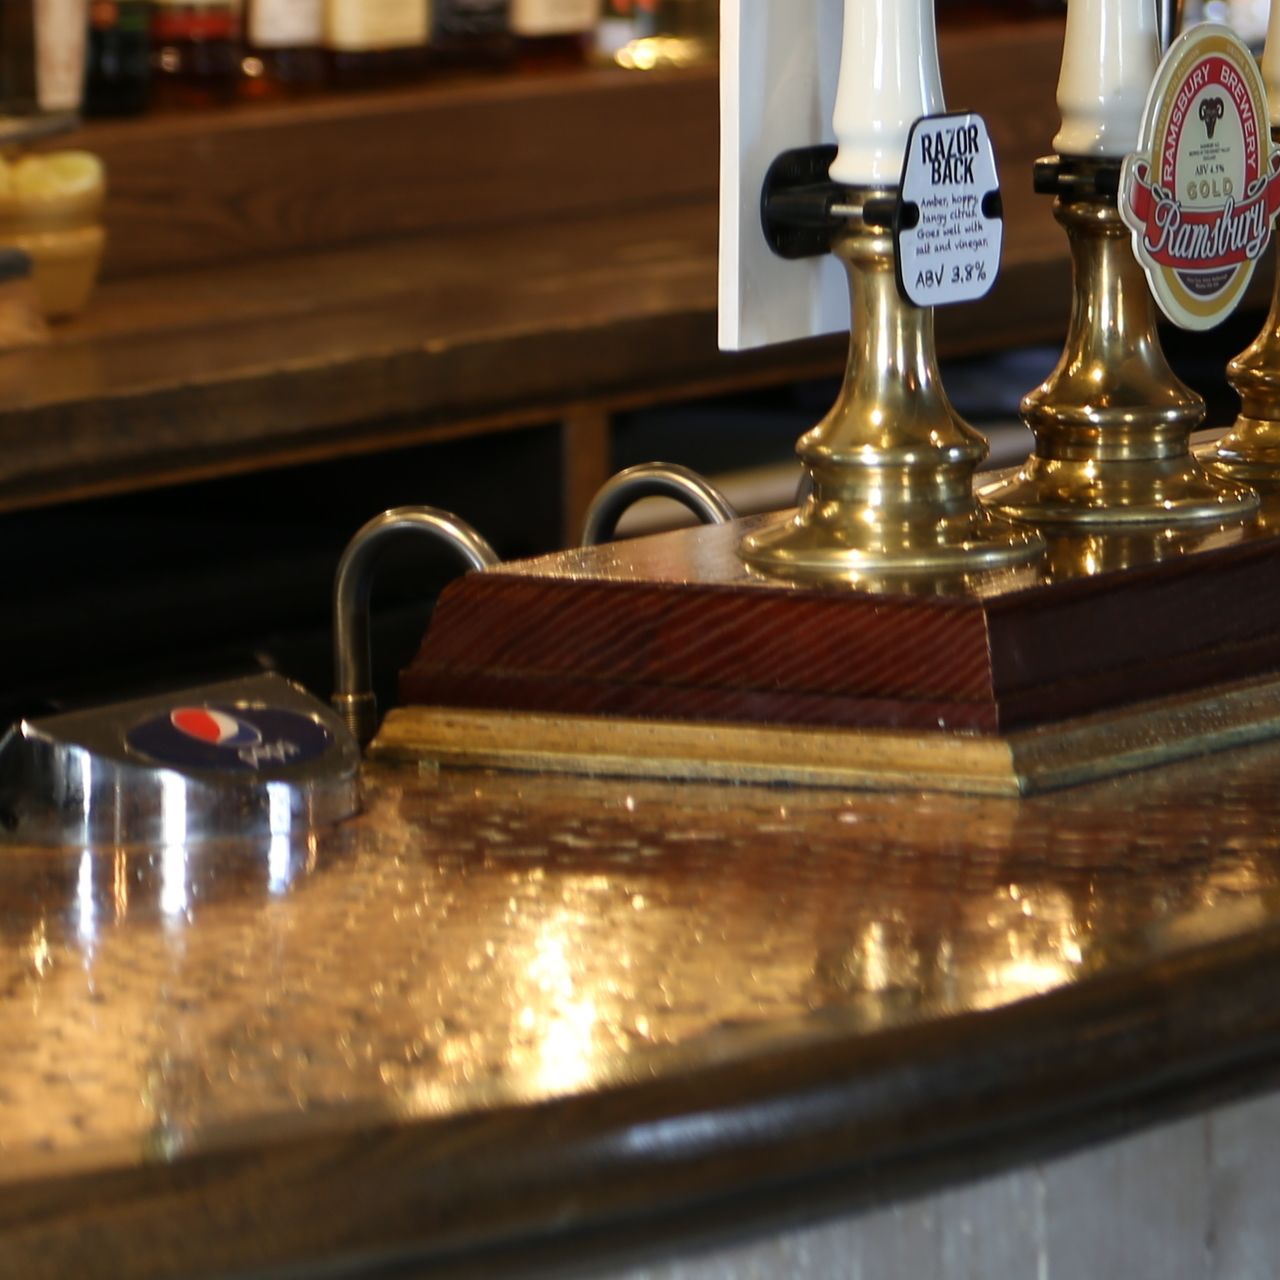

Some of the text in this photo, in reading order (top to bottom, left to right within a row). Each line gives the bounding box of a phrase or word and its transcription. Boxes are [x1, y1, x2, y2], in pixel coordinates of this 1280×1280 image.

[1163, 63, 1210, 181] RAMSBURY
[1220, 64, 1257, 169] BREWERY
[921, 124, 980, 165] RAZOR
[930, 156, 975, 186] BACK
[921, 193, 949, 207] Amber,
[1187, 177, 1234, 200] GOLD
[917, 221, 983, 240] Goes well with
[922, 211, 947, 227] tangy
[1144, 195, 1268, 259] Ramsbury
[916, 241, 931, 256] salt
[934, 239, 951, 252] and
[915, 260, 987, 288] ABV 3.8%
